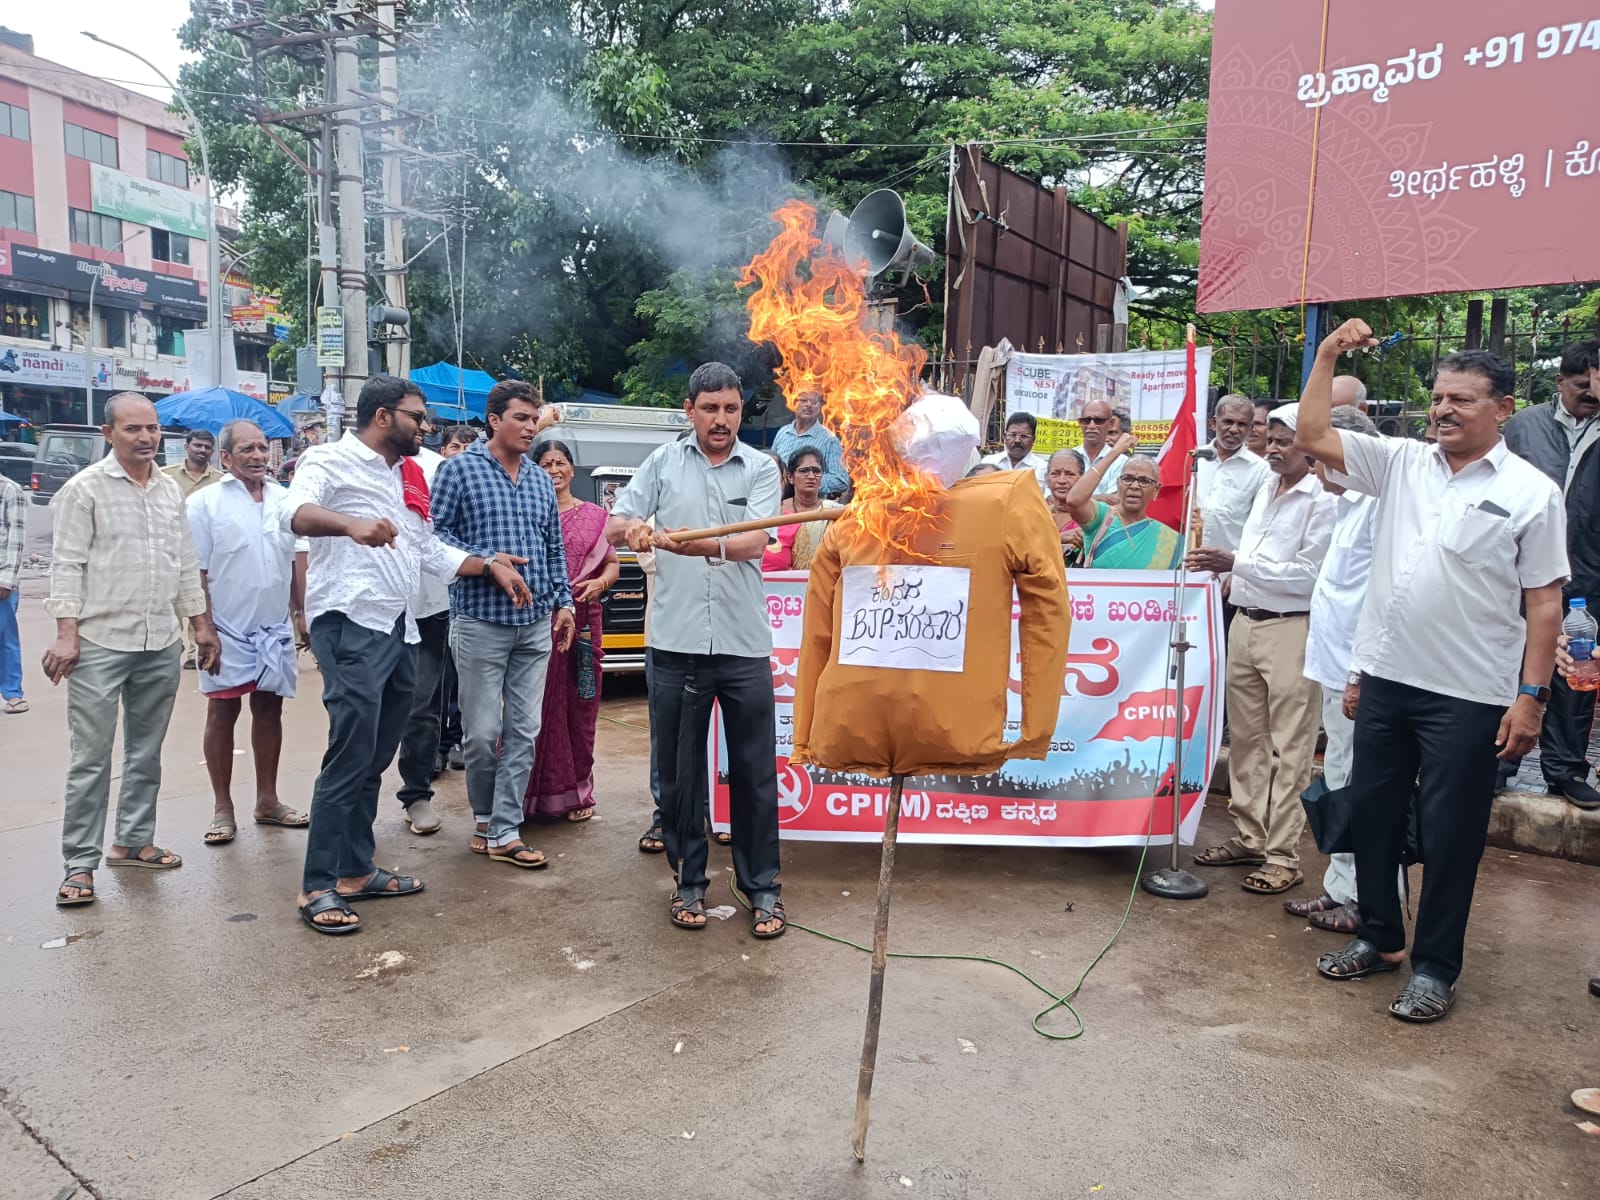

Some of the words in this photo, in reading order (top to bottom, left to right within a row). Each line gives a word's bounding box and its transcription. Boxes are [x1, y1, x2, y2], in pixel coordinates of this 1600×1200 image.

[1297, 43, 1443, 108] ಬ್ರಹ್ಮಾವರ
[1463, 33, 1525, 68] +91
[1388, 152, 1526, 199] ತೀರ್ಥಹಳ್ಳಿ
[22, 358, 64, 371] nandi
[1131, 371, 1155, 381] Ready
[1156, 370, 1166, 378] to
[1033, 380, 1056, 390] NEST
[1142, 381, 1185, 393] Apartment
[935, 800, 989, 825] ದಕ್ಷಿಣ
[1000, 801, 1058, 826] ಕನ್ನಡ
